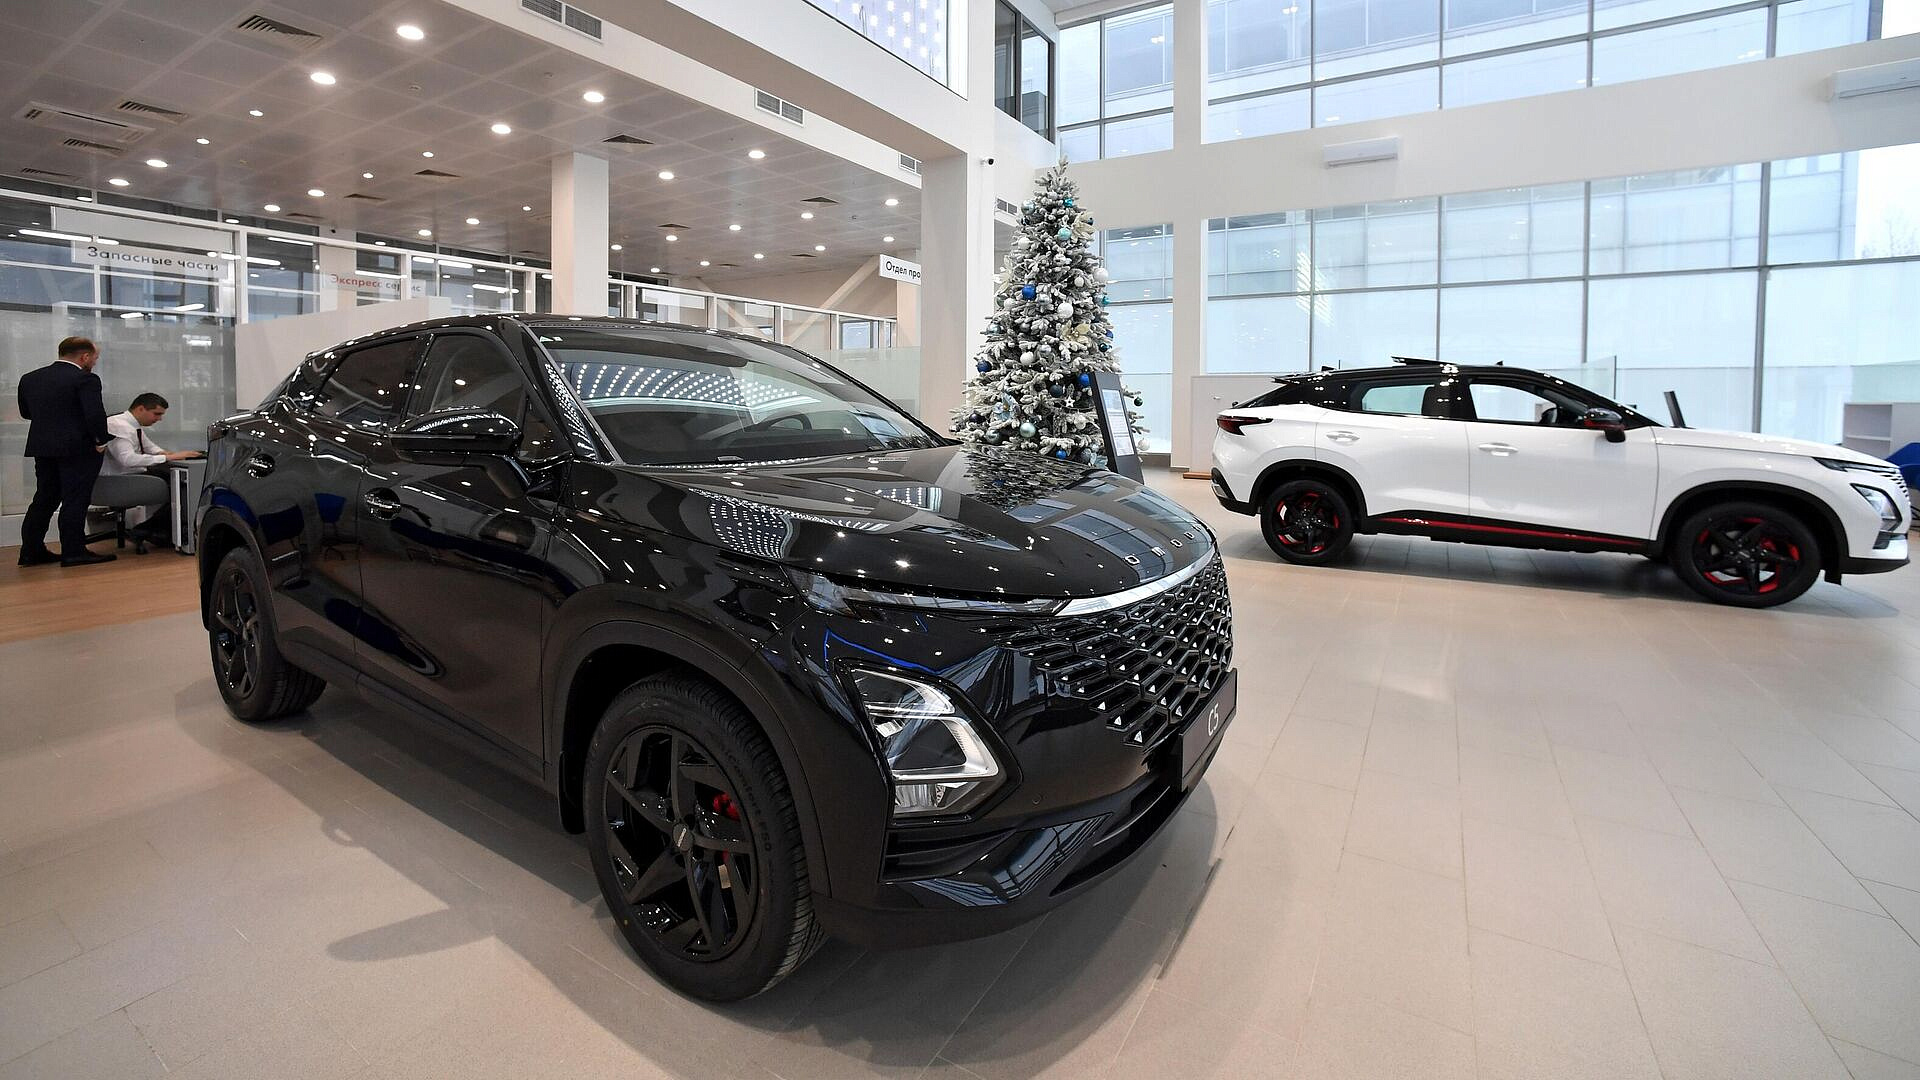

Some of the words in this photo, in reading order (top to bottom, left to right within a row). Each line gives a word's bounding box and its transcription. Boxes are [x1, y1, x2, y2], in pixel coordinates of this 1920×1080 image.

[87, 246, 172, 266] Запасные
[178, 260, 219, 272] части
[886, 261, 908, 275] Отдел
[908, 269, 921, 280] про
[330, 273, 383, 289] Экспресс
[385, 282, 421, 293] серис
[1208, 703, 1219, 736] C5
